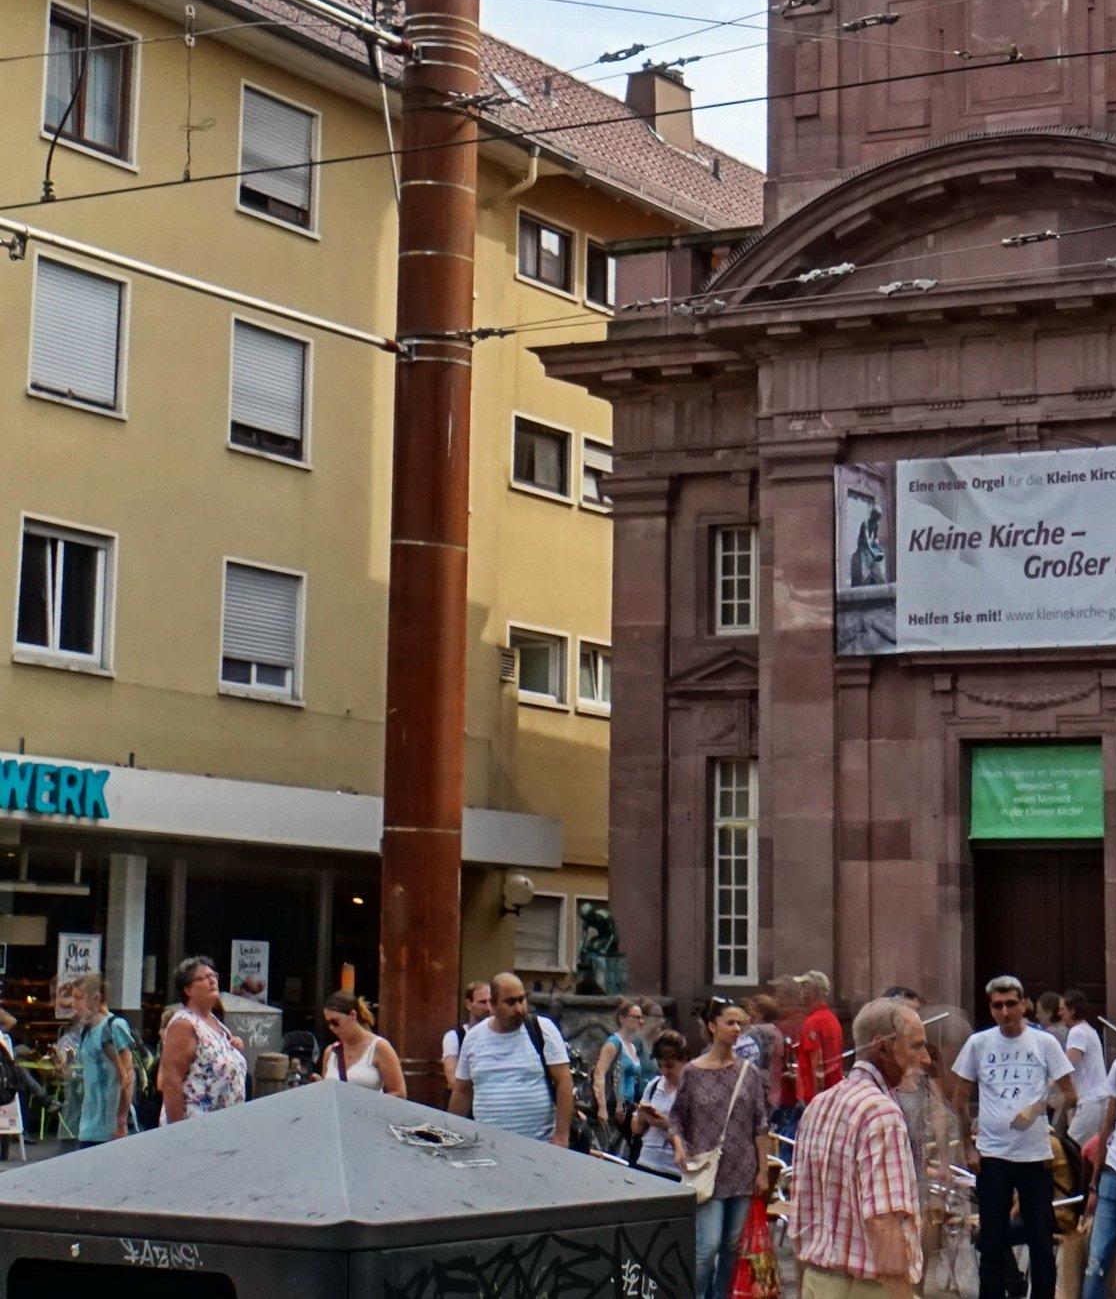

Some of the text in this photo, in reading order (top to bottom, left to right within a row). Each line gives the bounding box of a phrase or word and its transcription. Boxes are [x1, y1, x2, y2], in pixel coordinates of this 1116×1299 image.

[908, 479, 934, 493] Eine
[938, 479, 967, 491] neue
[972, 475, 1005, 492] Orgel
[1026, 473, 1044, 487] die
[1047, 470, 1087, 485] Kleine
[908, 525, 983, 552] Kleine
[989, 520, 1065, 548] Kirche
[1023, 550, 1111, 579] Großer
[908, 611, 949, 626] Helfen
[953, 610, 972, 624] Sie
[976, 609, 1002, 623] mit!
